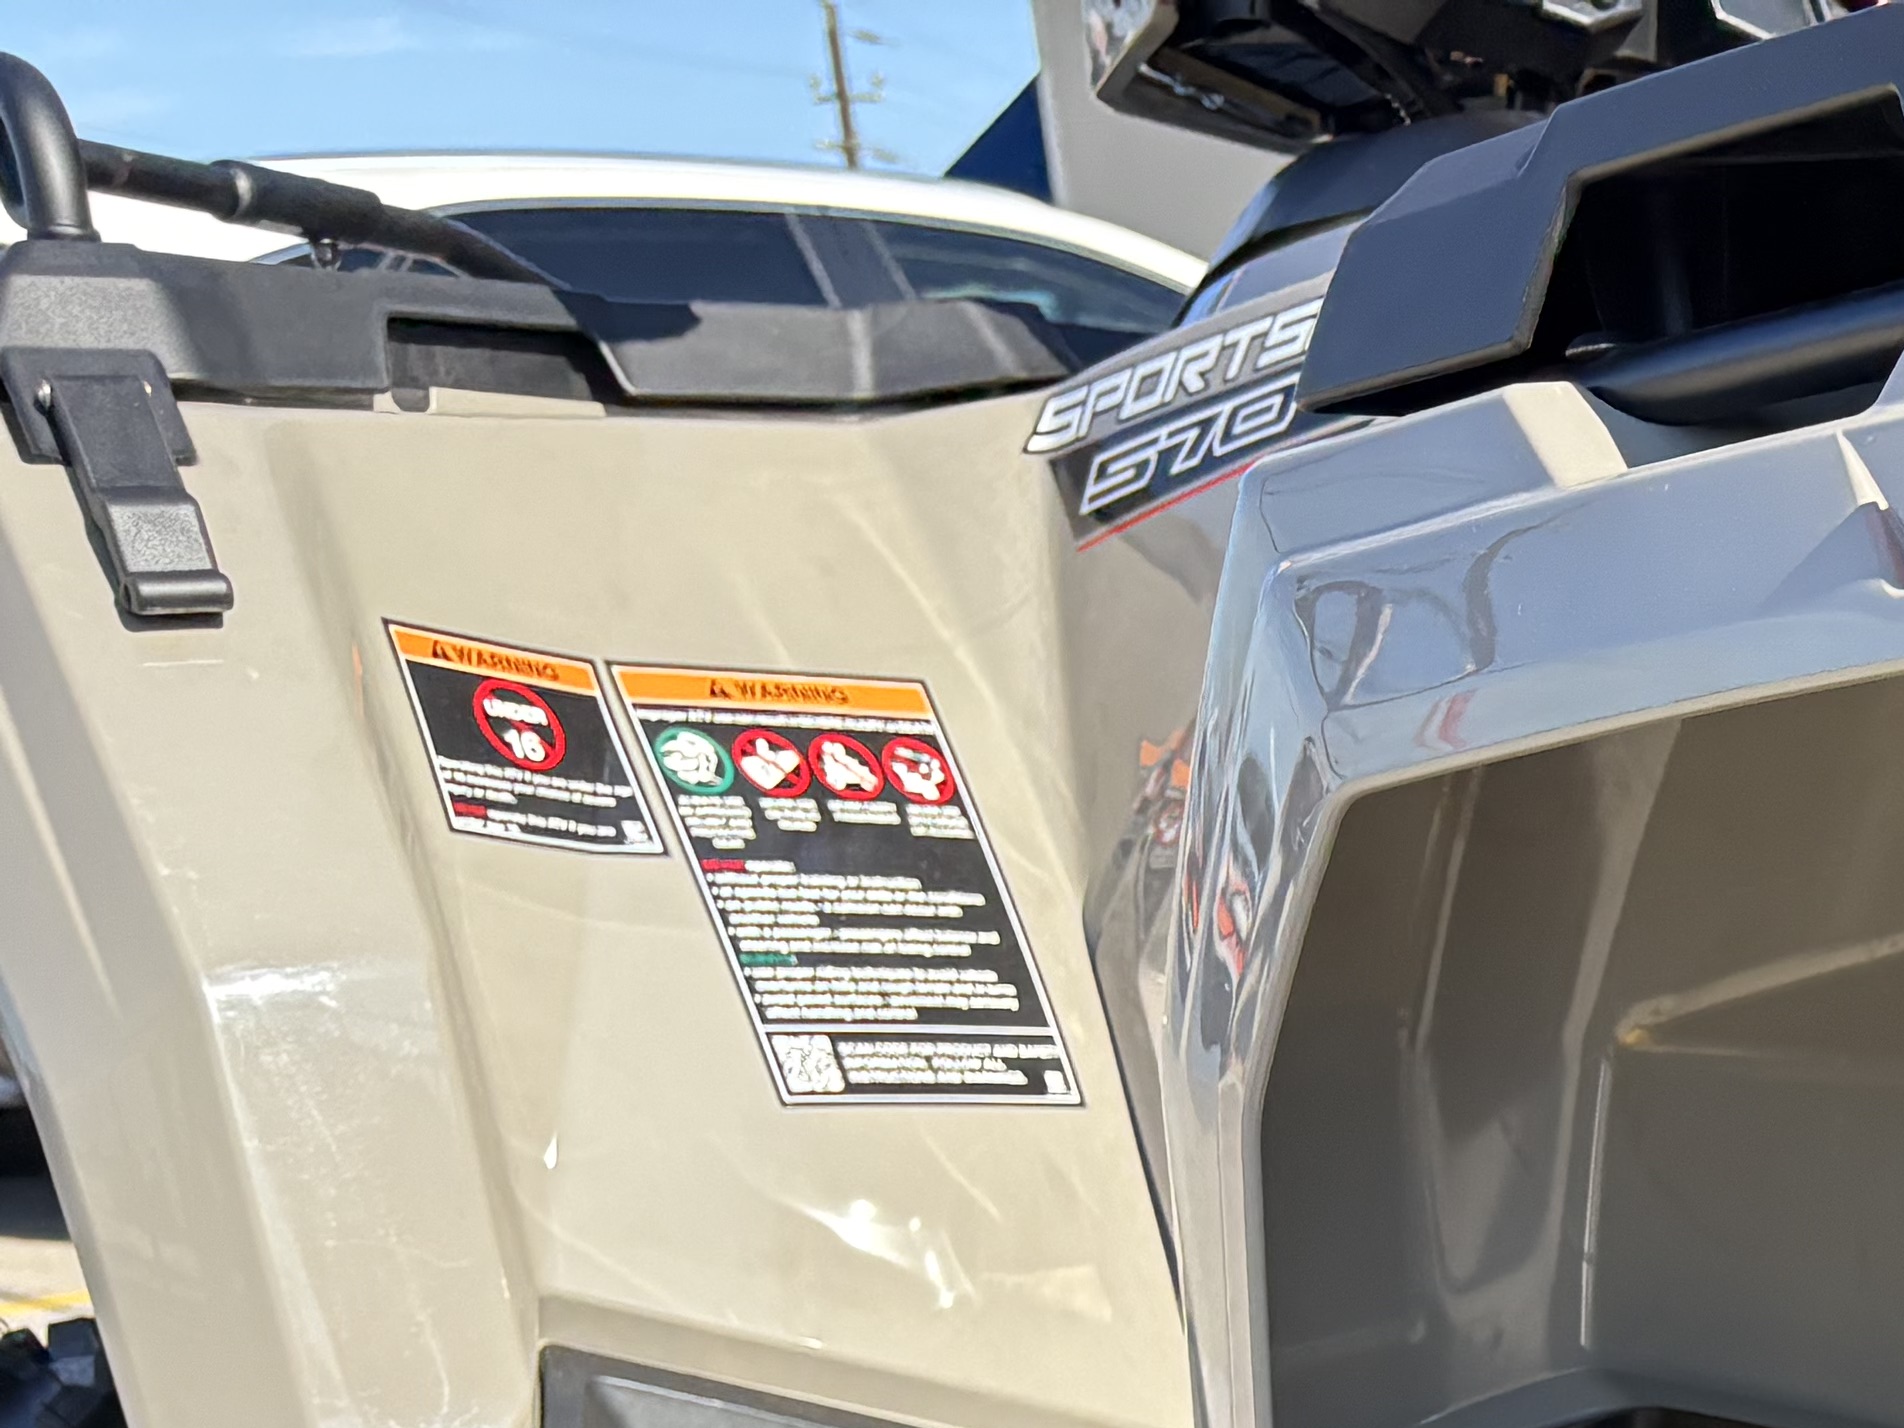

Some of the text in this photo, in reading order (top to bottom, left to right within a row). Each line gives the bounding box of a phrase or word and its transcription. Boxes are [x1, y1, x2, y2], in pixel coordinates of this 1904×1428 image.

[1024, 298, 1323, 452] SPORTS
[1080, 370, 1300, 515] 570
[450, 643, 559, 682] WARNING
[738, 680, 850, 704] WARNING
[504, 728, 546, 762] 16
